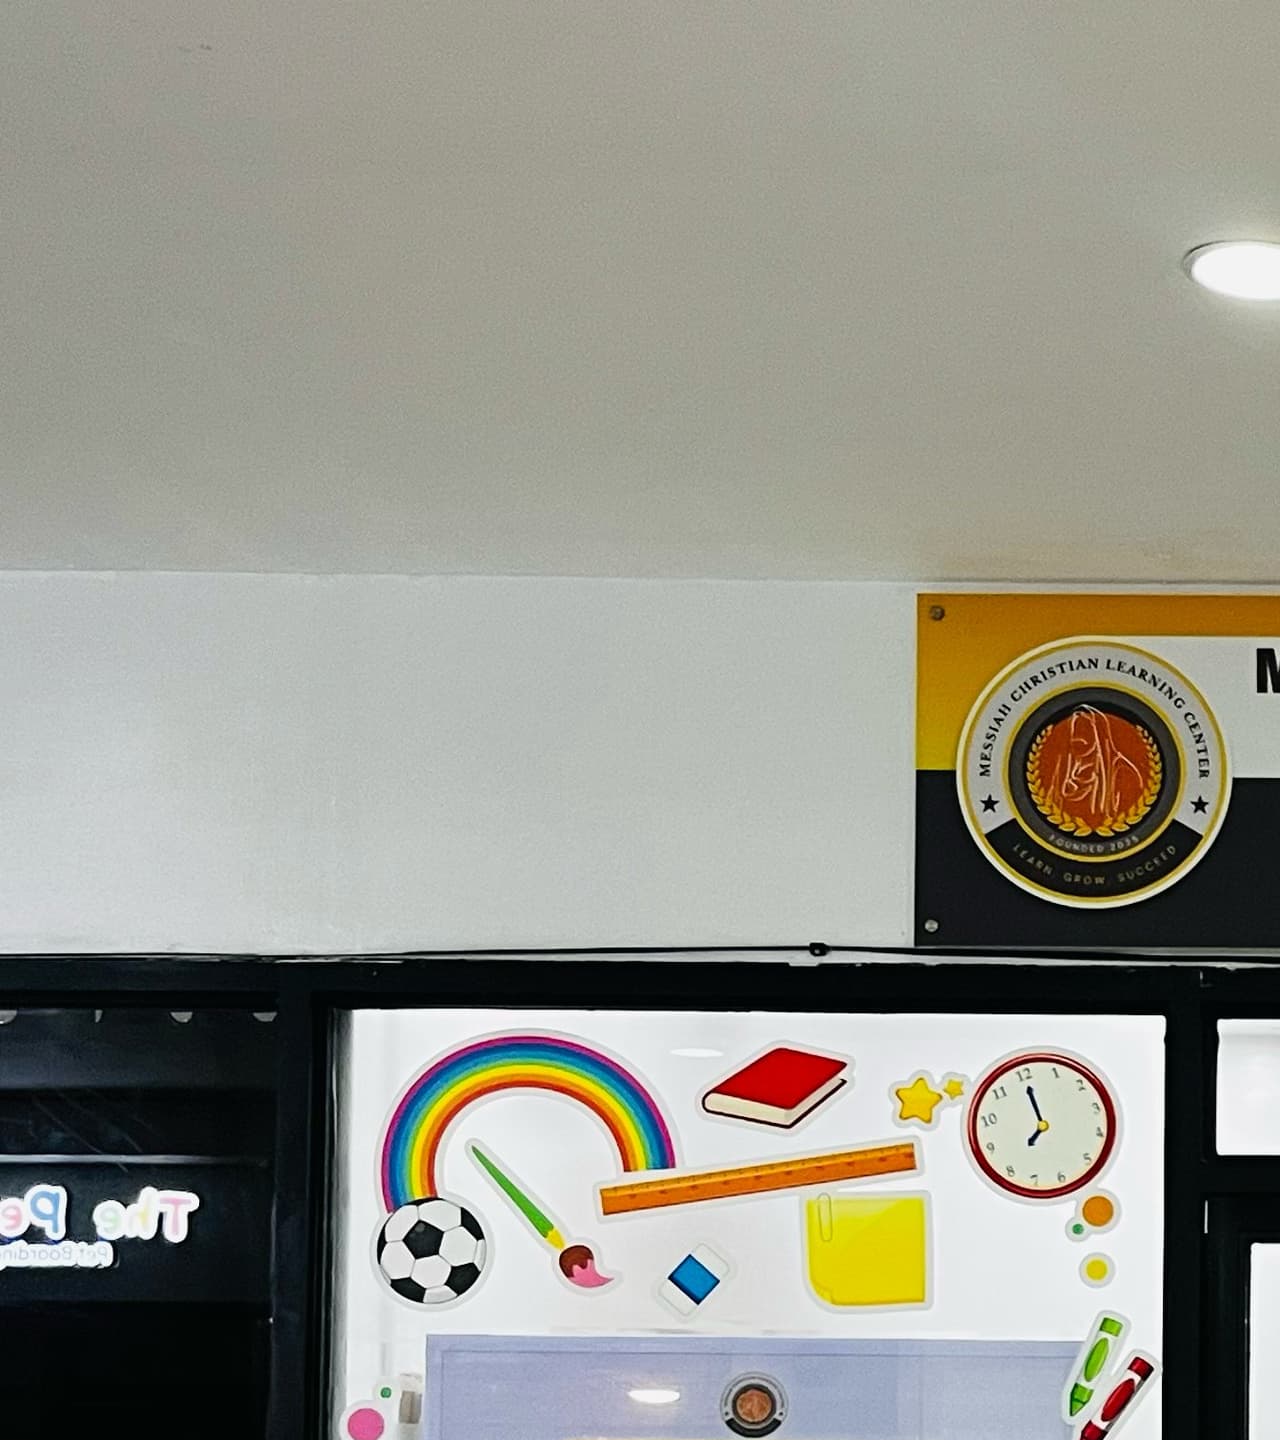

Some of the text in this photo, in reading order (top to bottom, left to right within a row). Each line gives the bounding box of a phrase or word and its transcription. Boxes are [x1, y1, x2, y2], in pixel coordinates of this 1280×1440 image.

[979, 657, 1210, 779] MESSIAH CHRISTIAN LEARNING CENTER
[1013, 844, 1176, 885] LEARN GROW SUCCEED
